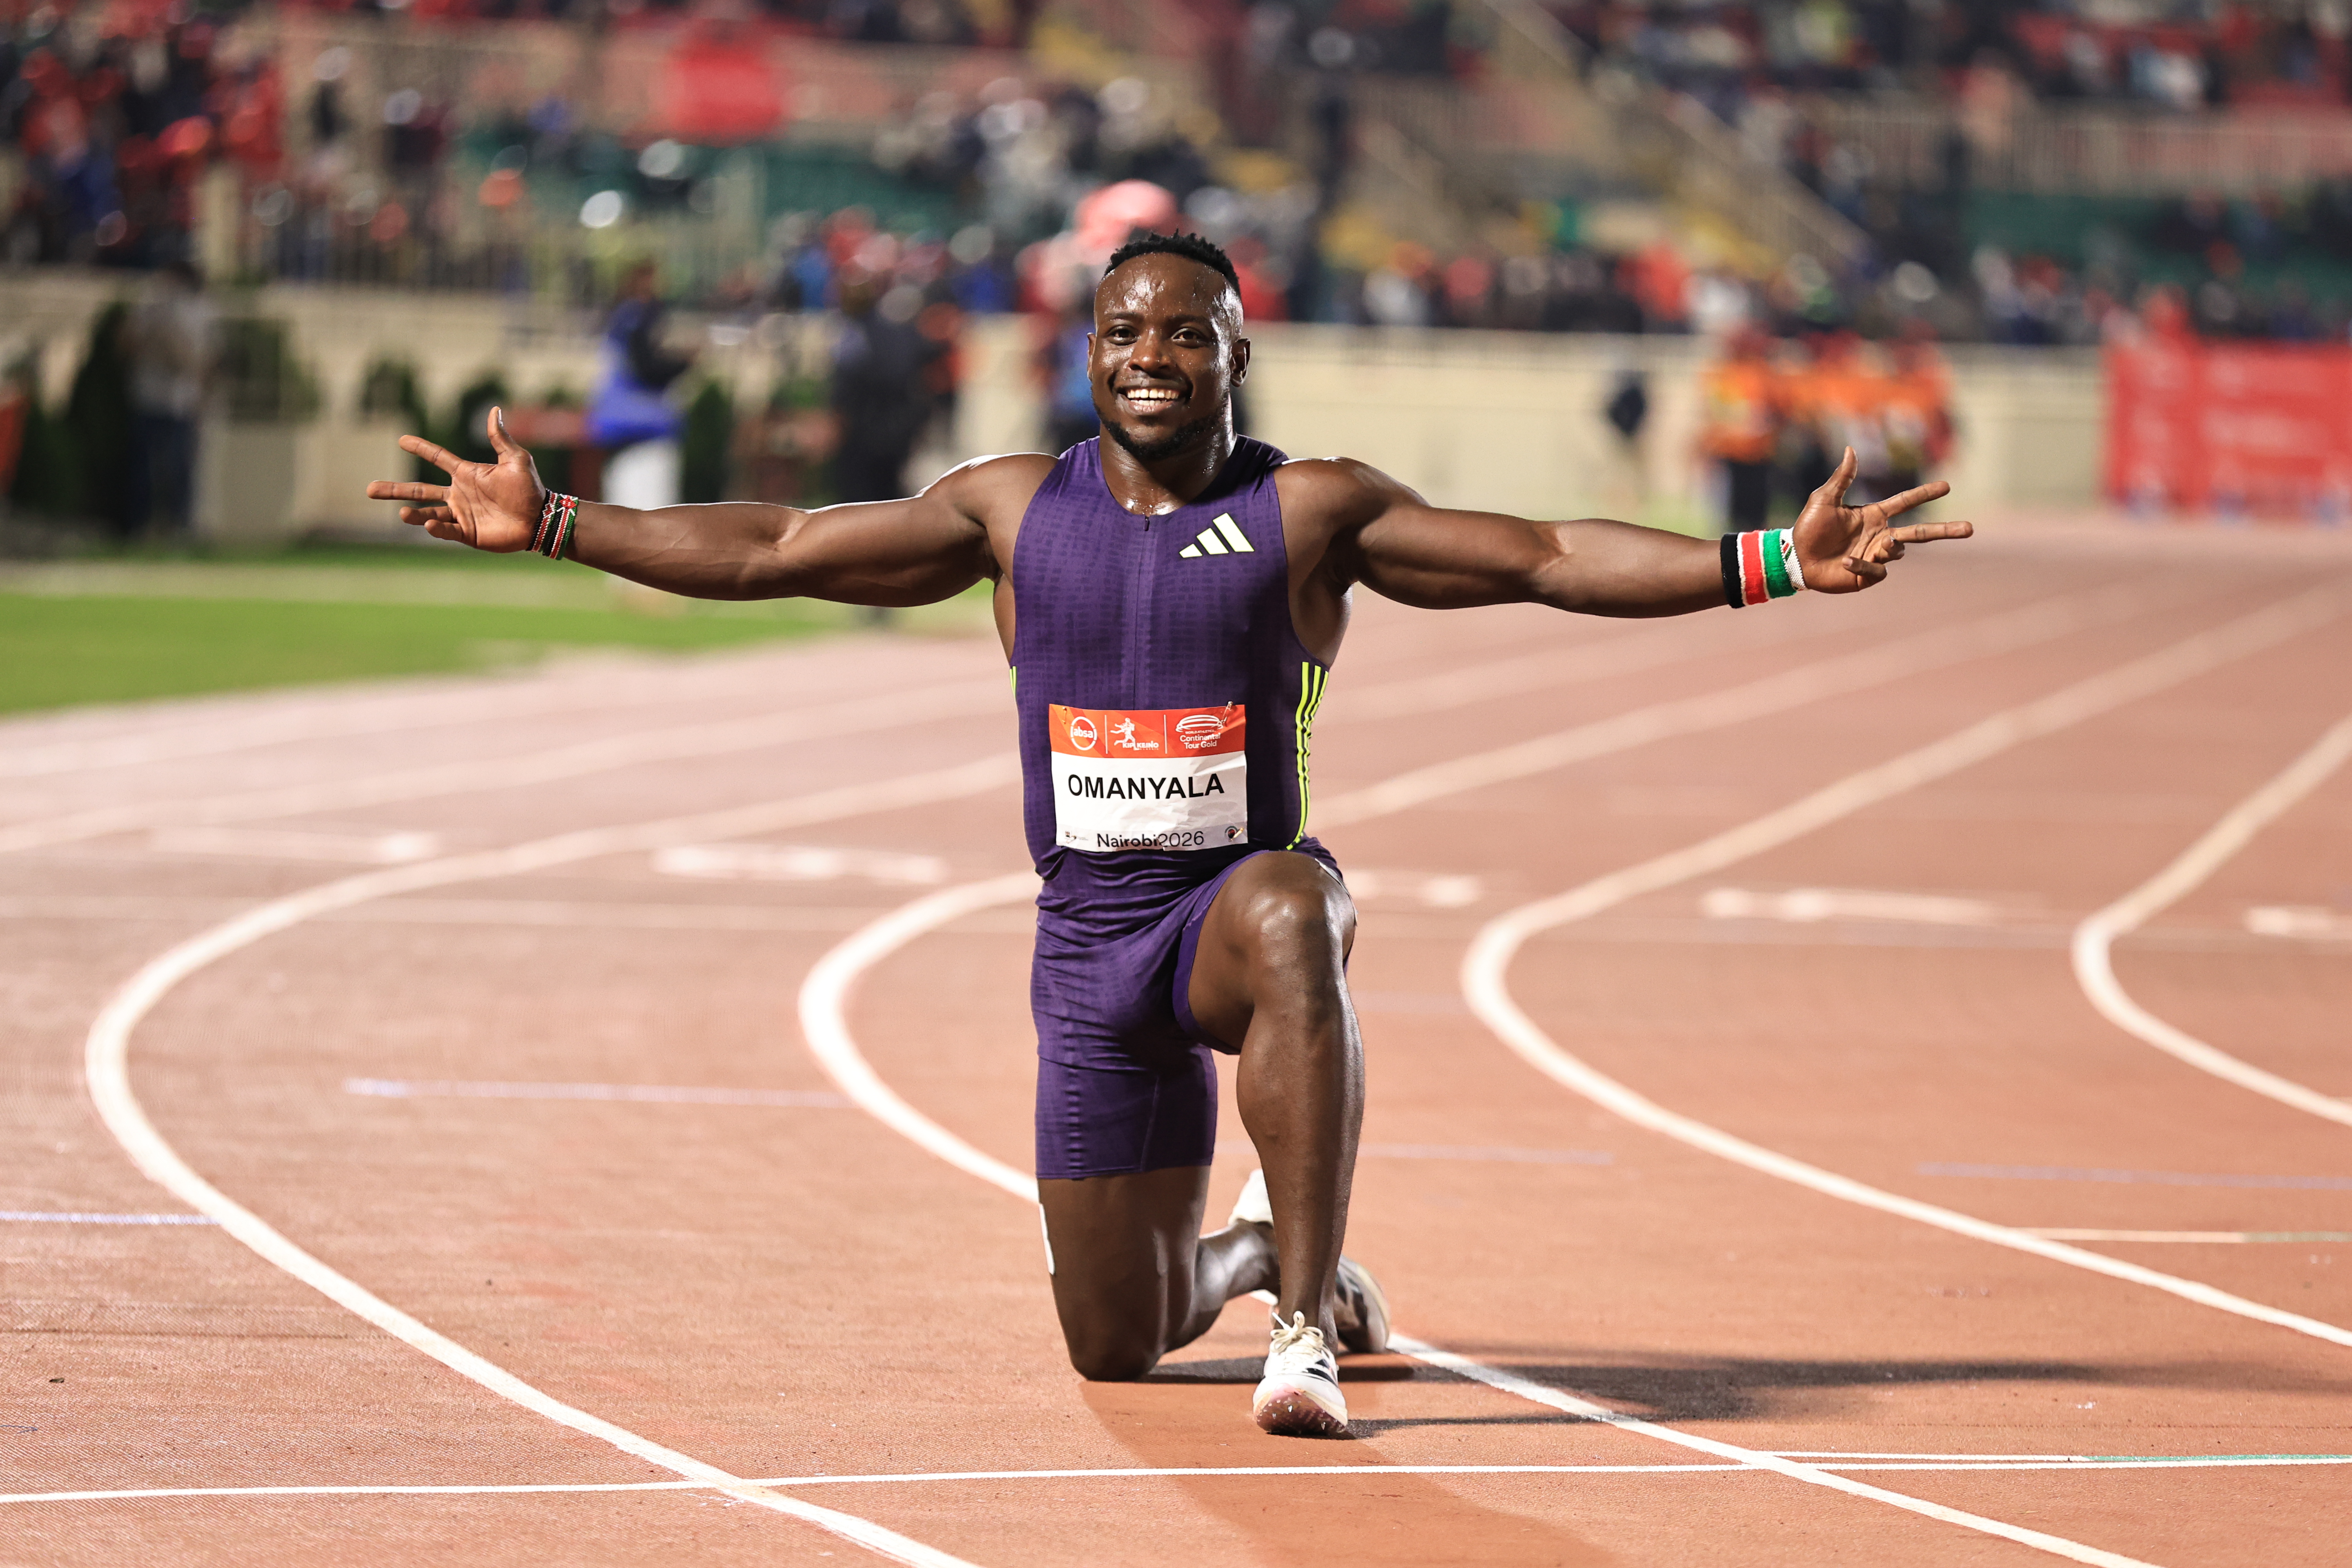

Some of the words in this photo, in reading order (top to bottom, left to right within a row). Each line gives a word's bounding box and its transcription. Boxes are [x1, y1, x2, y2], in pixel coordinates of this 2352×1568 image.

[1073, 726, 1094, 738] absa
[1180, 732, 1221, 742] Continental
[1068, 773, 1225, 799] OMANYALA
